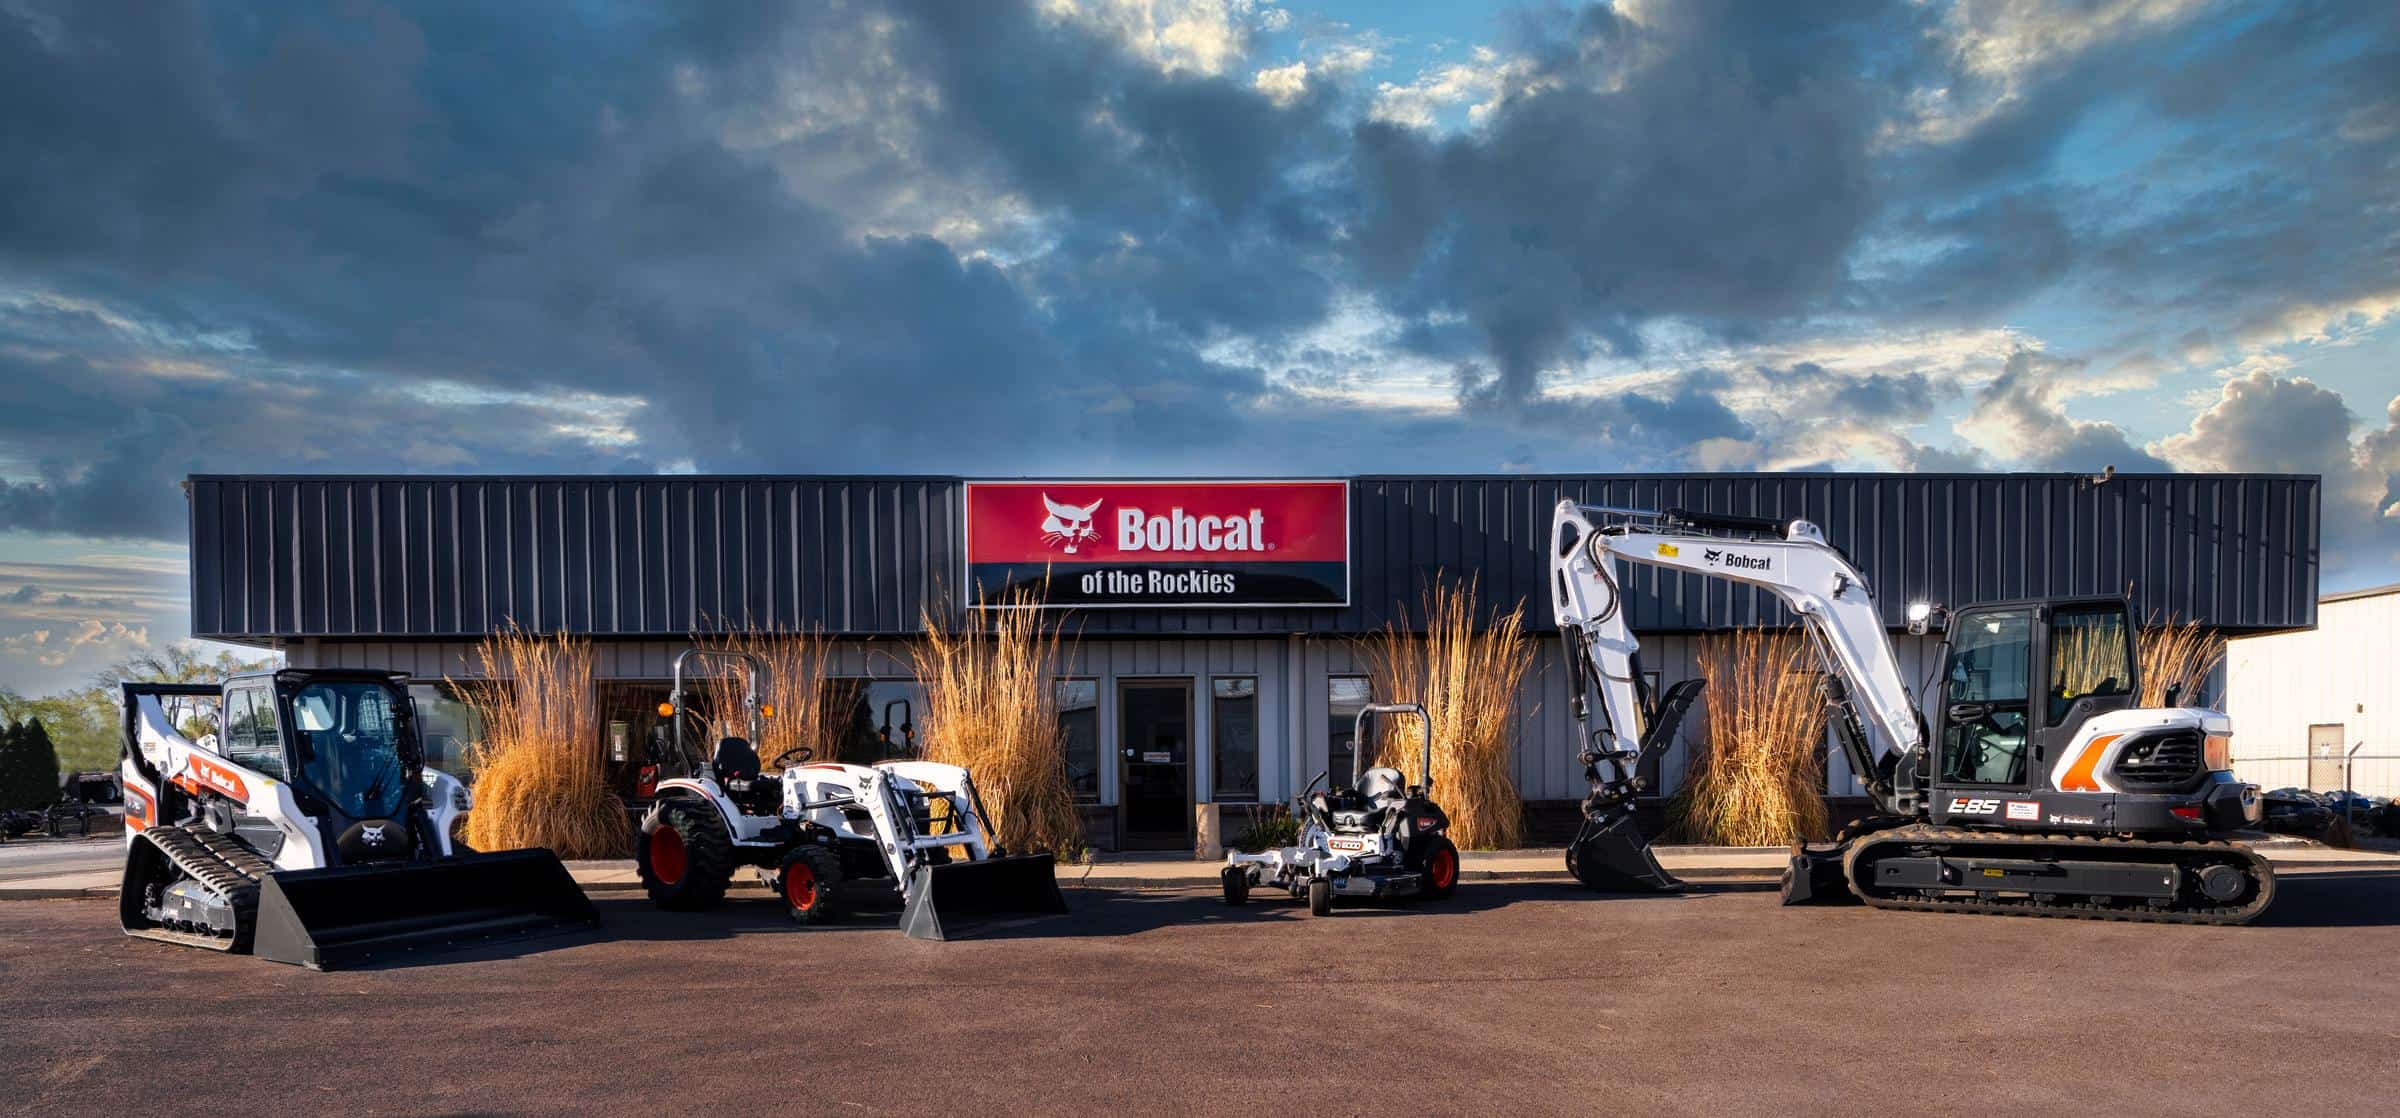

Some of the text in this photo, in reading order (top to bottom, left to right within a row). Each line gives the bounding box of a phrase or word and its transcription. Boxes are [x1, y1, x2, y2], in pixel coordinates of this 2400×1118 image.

[1117, 507, 1265, 552] Bobcat
[1725, 553, 1771, 571] Bobcat
[1081, 569, 1236, 594] of the Rockies
[1947, 798, 2001, 814] E85
